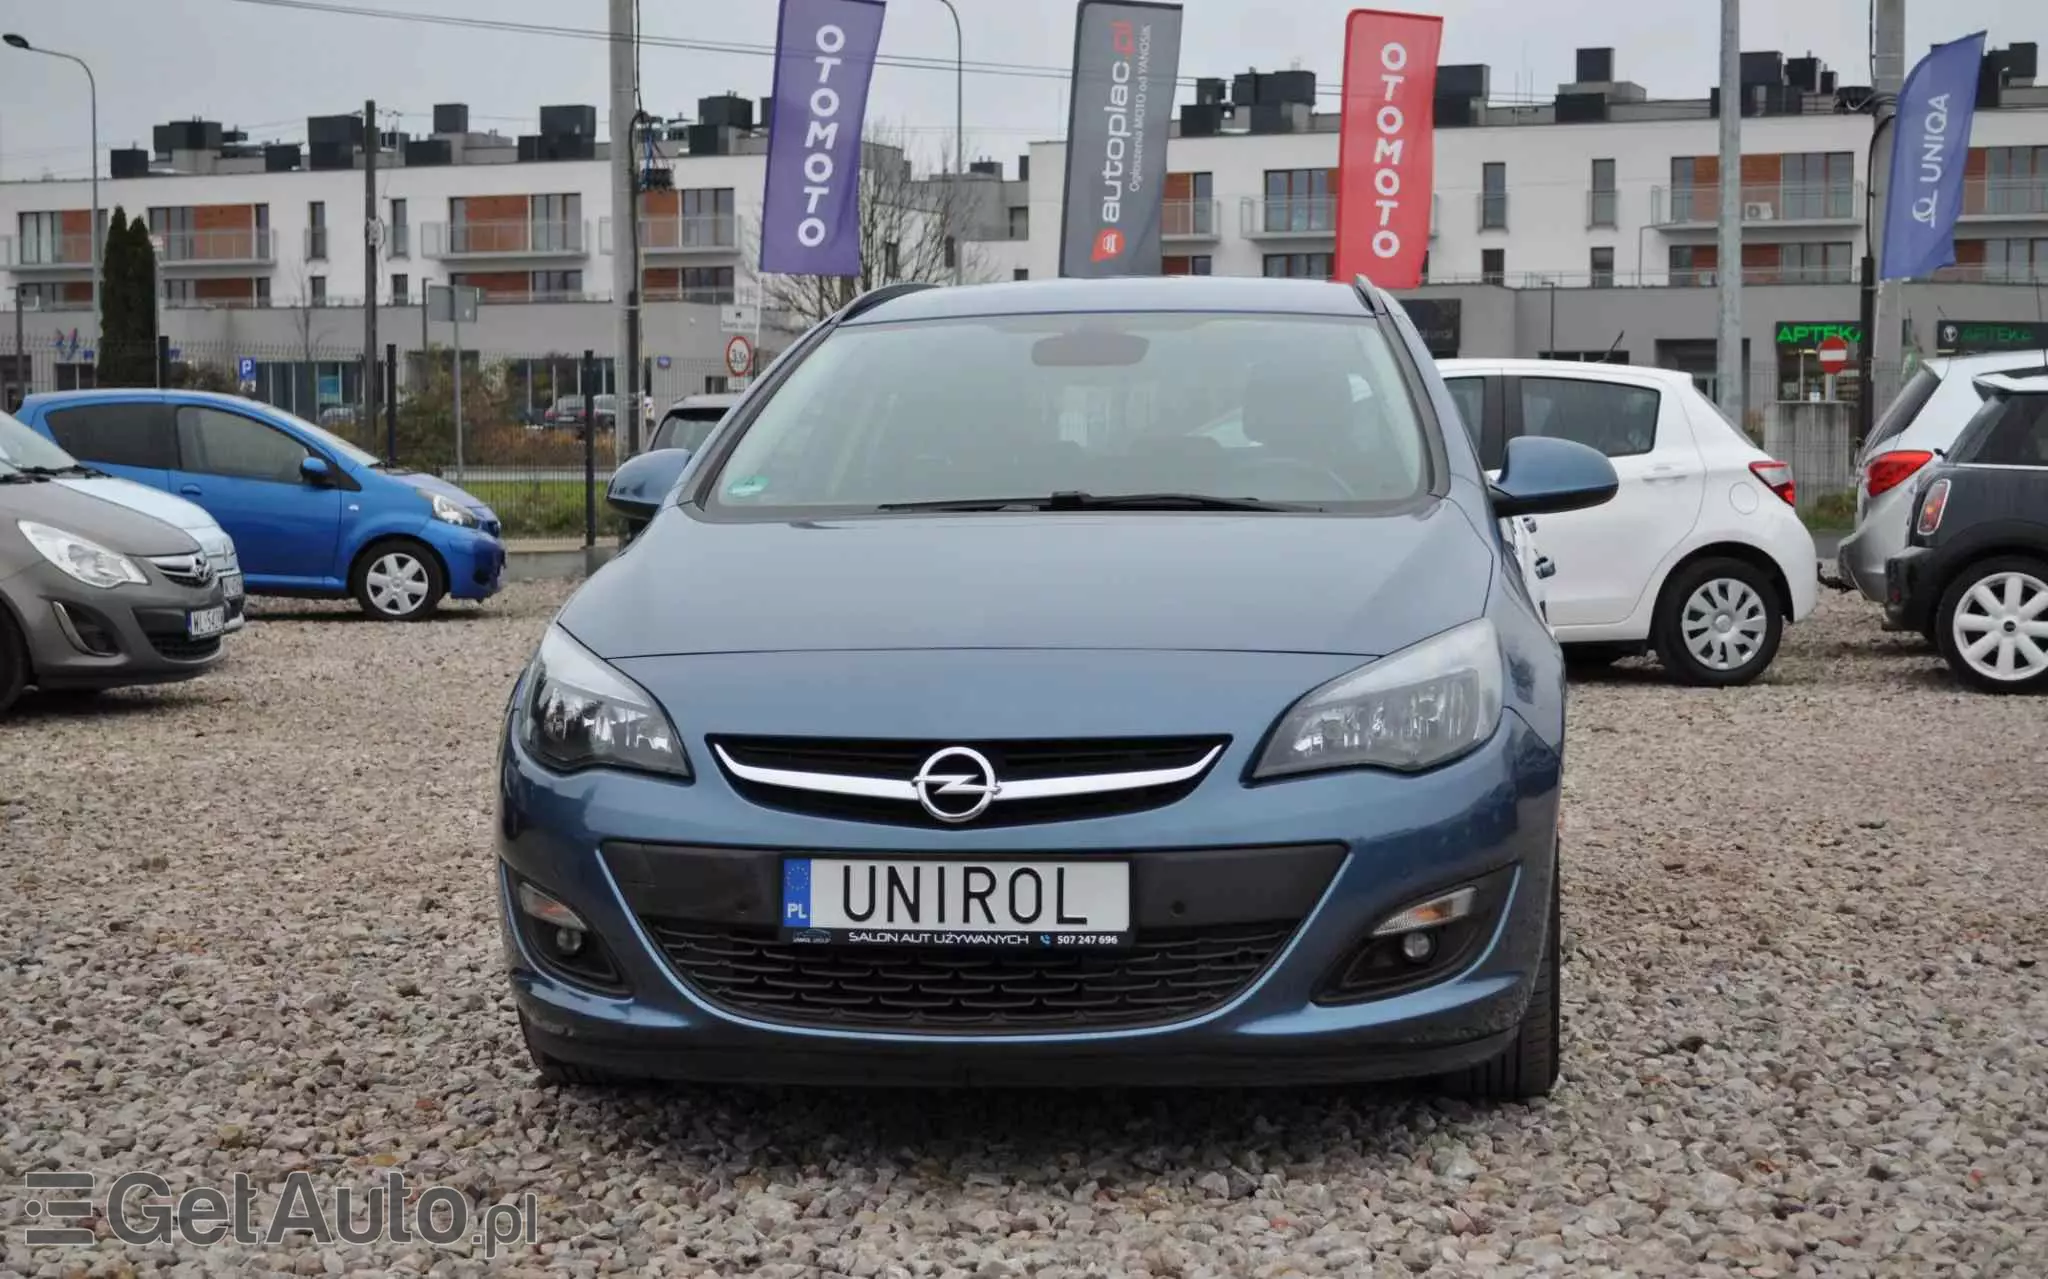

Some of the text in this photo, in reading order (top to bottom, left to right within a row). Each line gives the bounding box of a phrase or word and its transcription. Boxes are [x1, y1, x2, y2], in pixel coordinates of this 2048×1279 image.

[798, 24, 845, 247] OTOMOTO
[1102, 21, 1135, 223] autoplac.pl
[1129, 25, 1151, 192] Ogłoszenia MOTO od YANOSIK
[1372, 42, 1407, 258] OTOMOTO
[1920, 92, 1950, 182] UNIQA
[787, 903, 807, 919] PL
[843, 865, 1088, 925] UNIROL
[848, 931, 1029, 945] SALON AUT UŻYWANYCH
[1057, 935, 1118, 945] 507 247 696
